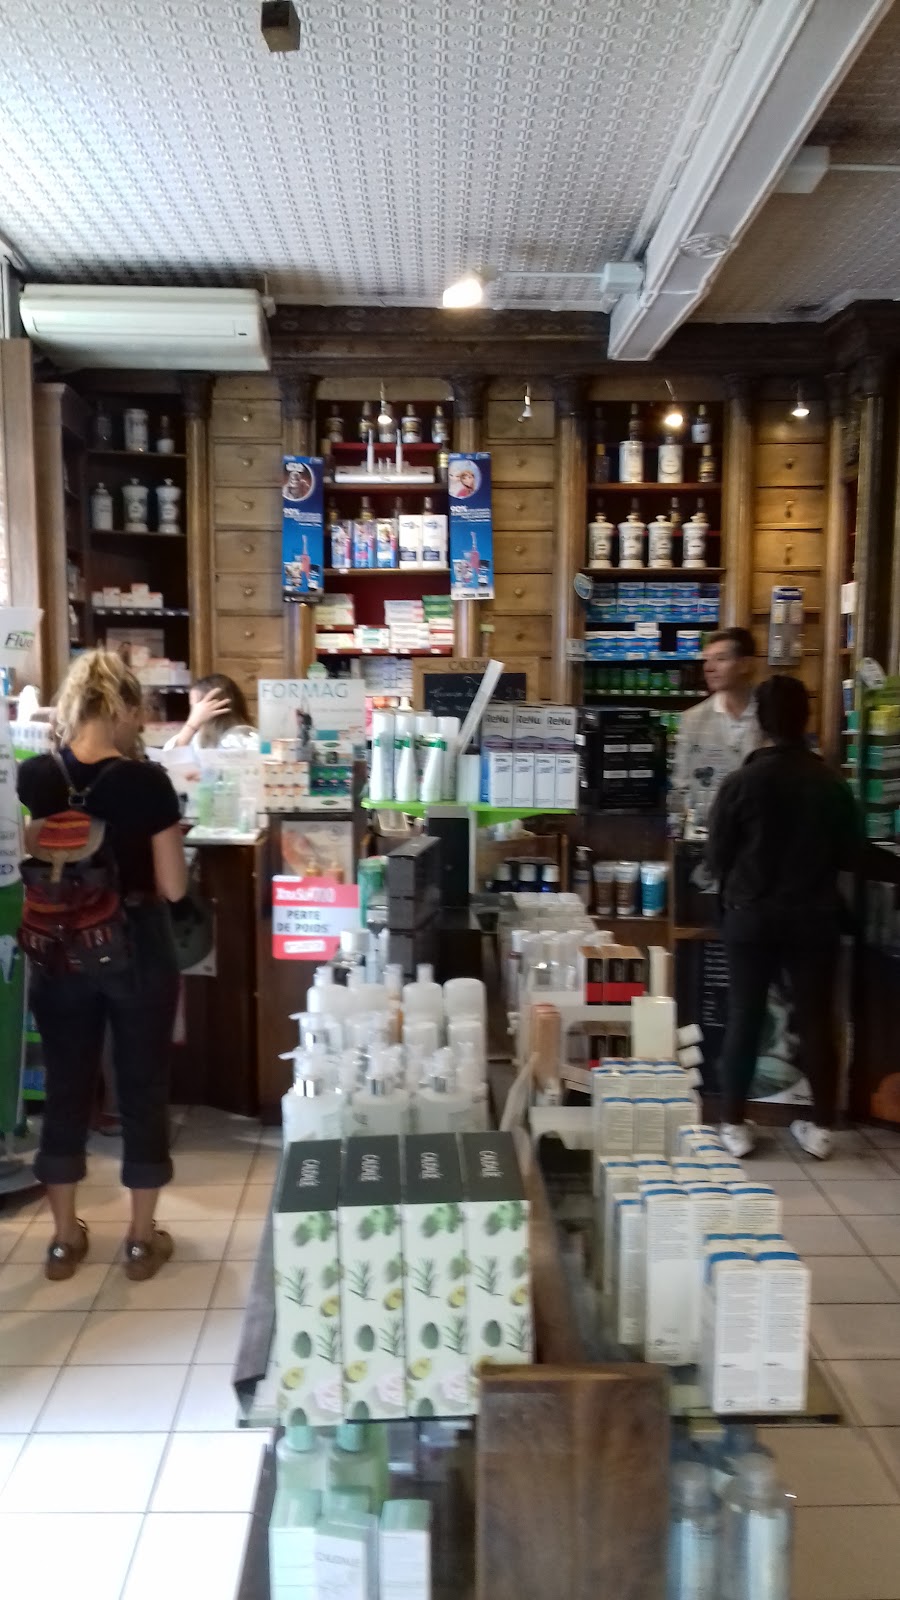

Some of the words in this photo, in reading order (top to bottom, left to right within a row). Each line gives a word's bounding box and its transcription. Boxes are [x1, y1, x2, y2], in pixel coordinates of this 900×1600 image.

[261, 682, 348, 698] FORMAG
[516, 715, 541, 725] ReNu
[547, 716, 572, 726] ReNu
[287, 910, 321, 920] PERTE
[276, 922, 291, 933] DE
[295, 923, 329, 933] POIDS
